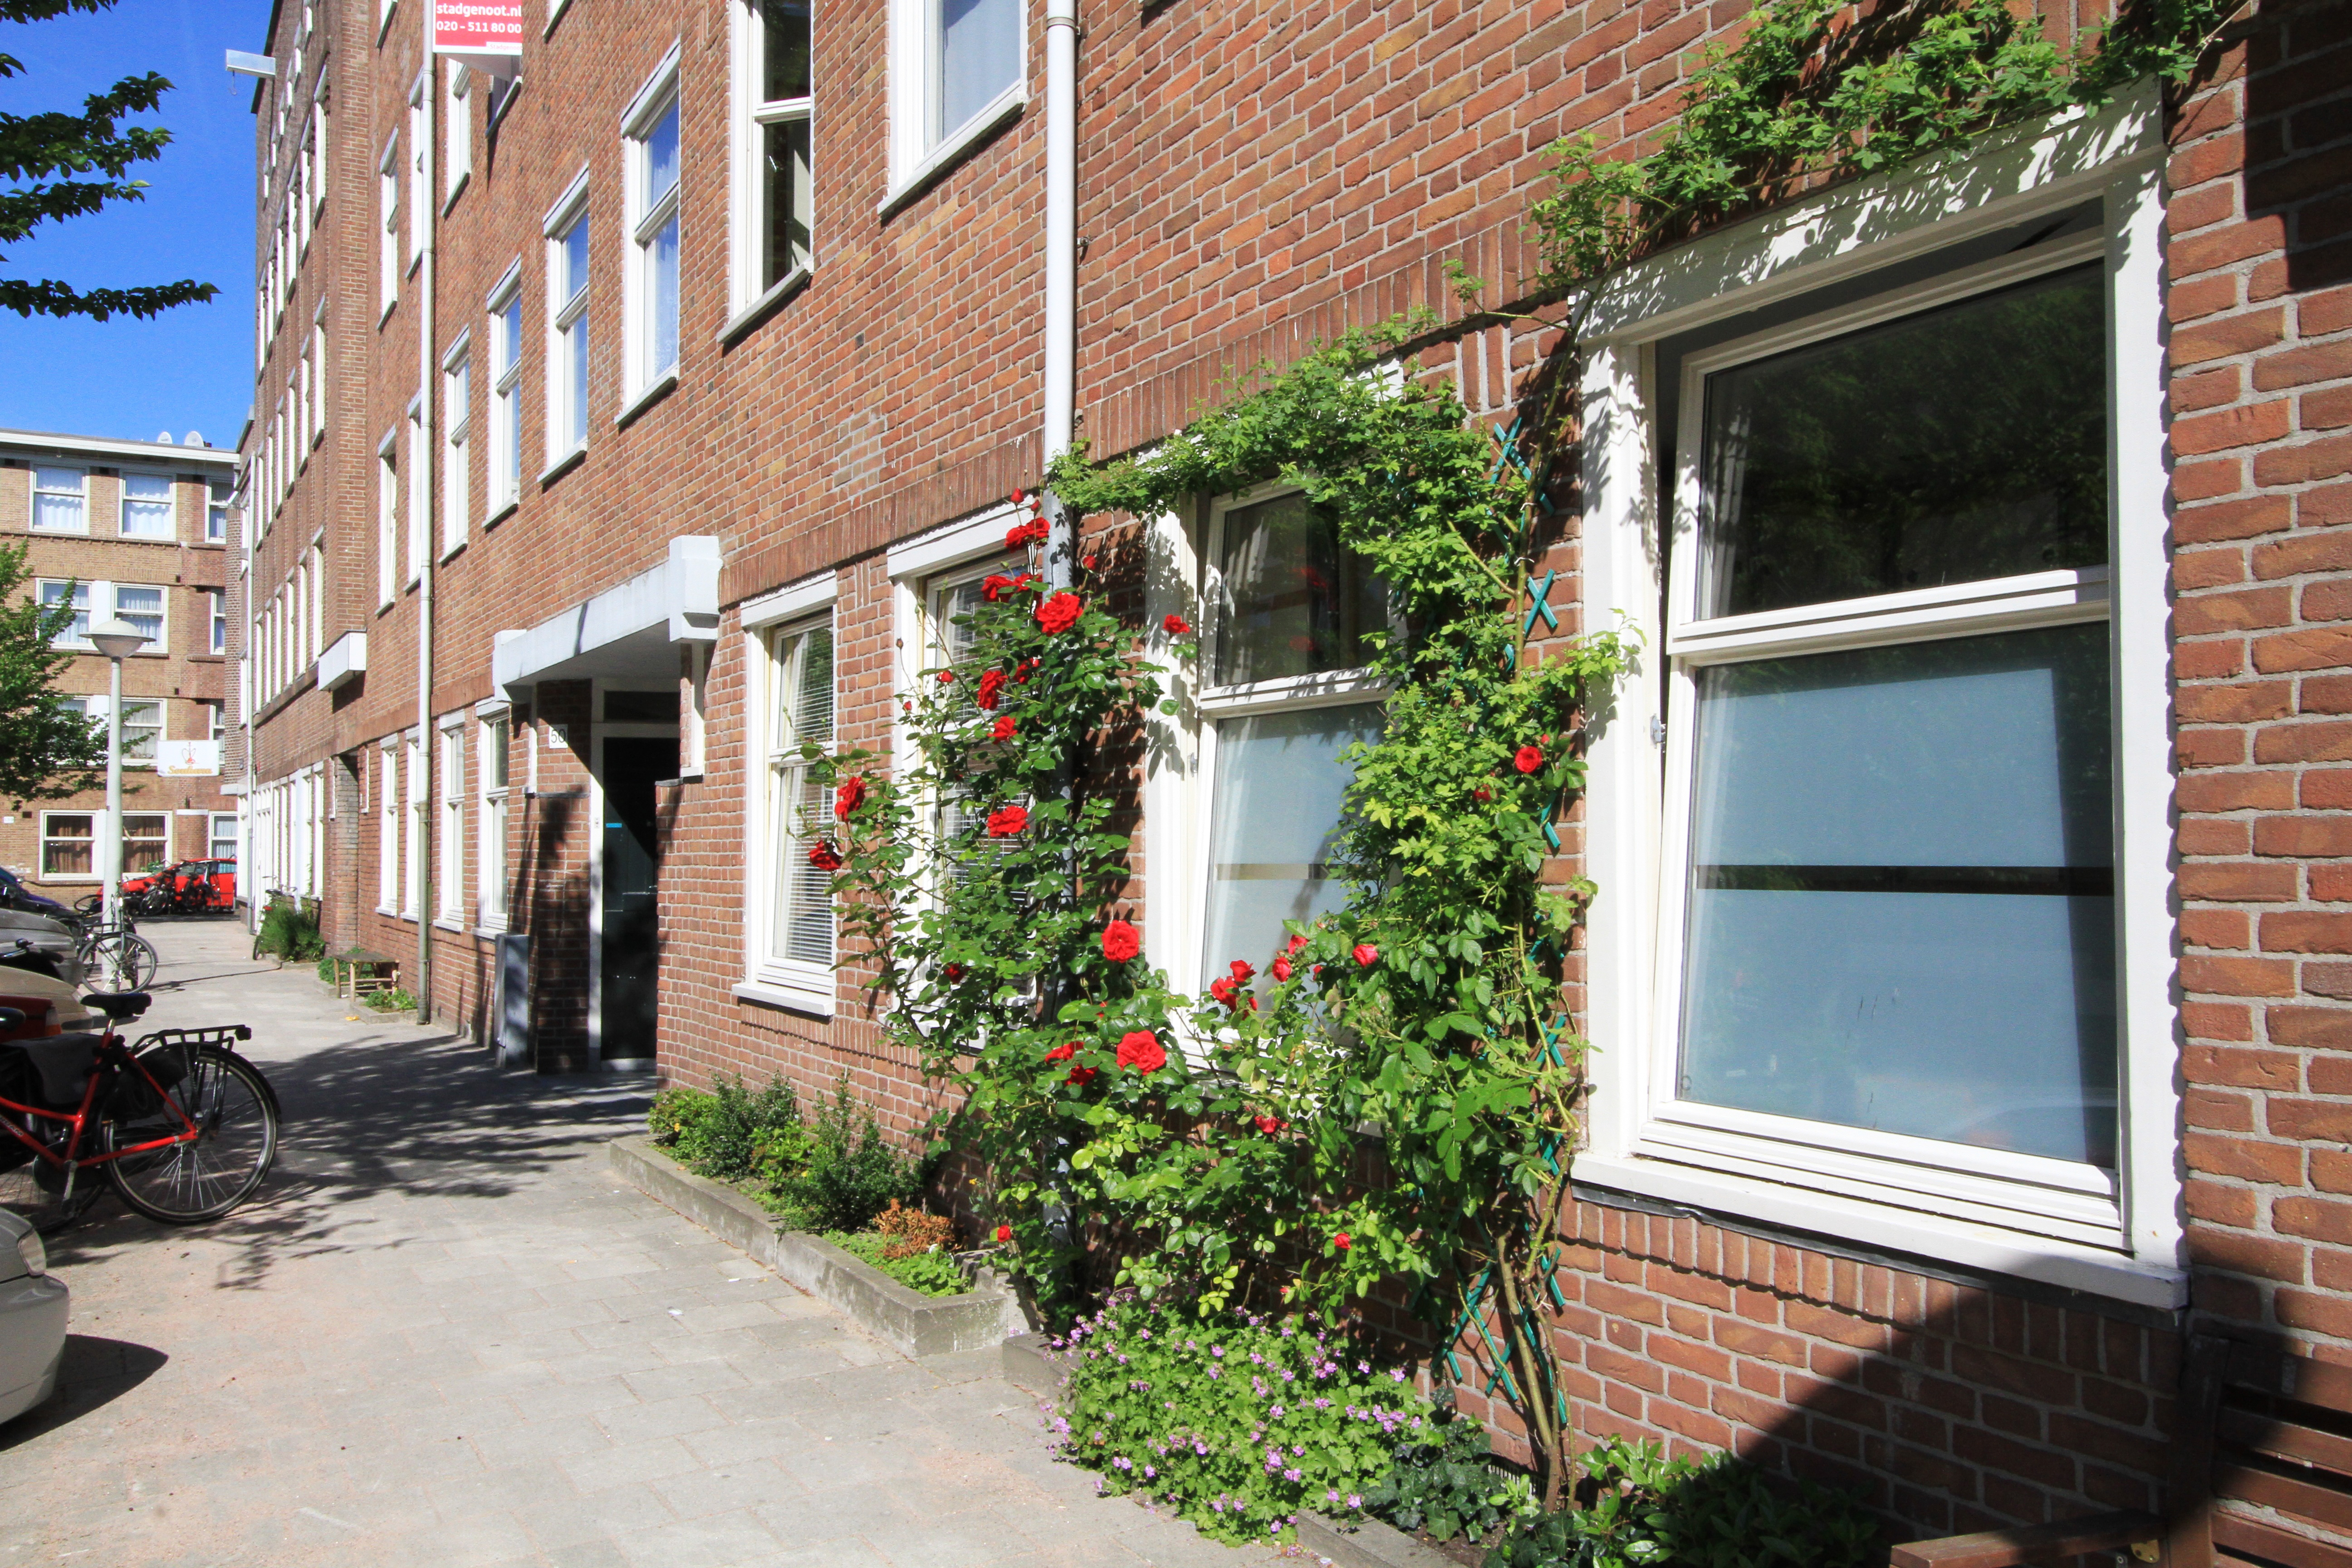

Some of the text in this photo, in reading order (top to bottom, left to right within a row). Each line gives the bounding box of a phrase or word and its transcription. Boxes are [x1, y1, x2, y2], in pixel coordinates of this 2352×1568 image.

[436, 3, 522, 17] stadgenoot.nl
[436, 21, 458, 31] 020
[468, 22, 489, 32] 511
[491, 23, 505, 33] 80
[507, 23, 522, 34] 00
[551, 729, 566, 743] 50
